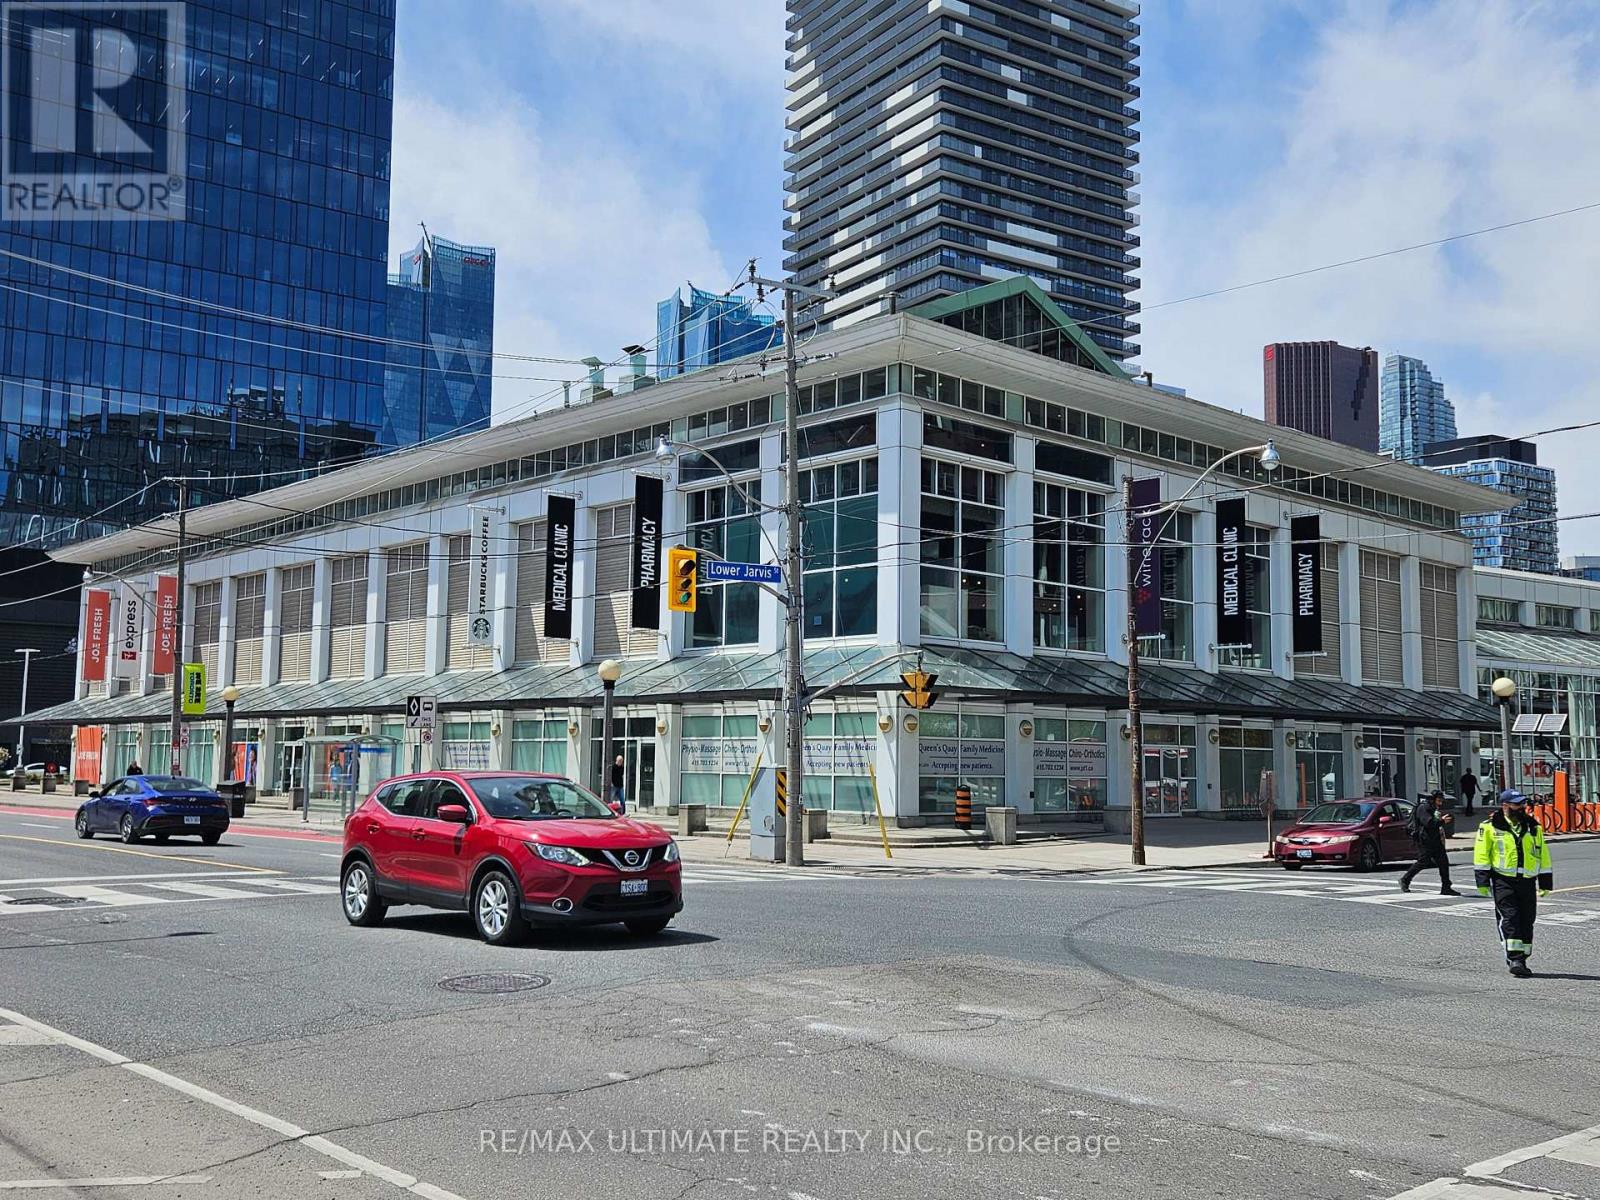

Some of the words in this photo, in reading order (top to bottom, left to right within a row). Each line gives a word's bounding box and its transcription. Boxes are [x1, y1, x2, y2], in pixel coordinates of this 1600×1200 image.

[481, 516, 489, 553] COFFEE
[554, 524, 569, 559] CLINIC
[1223, 526, 1238, 562] CLINIC
[641, 517, 656, 589] PHARMACY
[711, 562, 740, 577] Lower
[744, 565, 772, 579] Jarvis
[480, 555, 488, 615] STARBUCKS
[552, 562, 568, 612] MEDICAL
[1224, 565, 1239, 616] MEDICAL
[1298, 553, 1314, 616] PHARMACY
[93, 608, 103, 640] FRESH
[125, 600, 138, 649] express
[163, 595, 173, 630] FRESH
[92, 644, 101, 663] JOE
[162, 634, 171, 655] JOE
[919, 743, 941, 754] Queen's
[942, 745, 957, 755] Quay
[960, 745, 978, 755] Family
[979, 746, 1004, 754] Medicine
